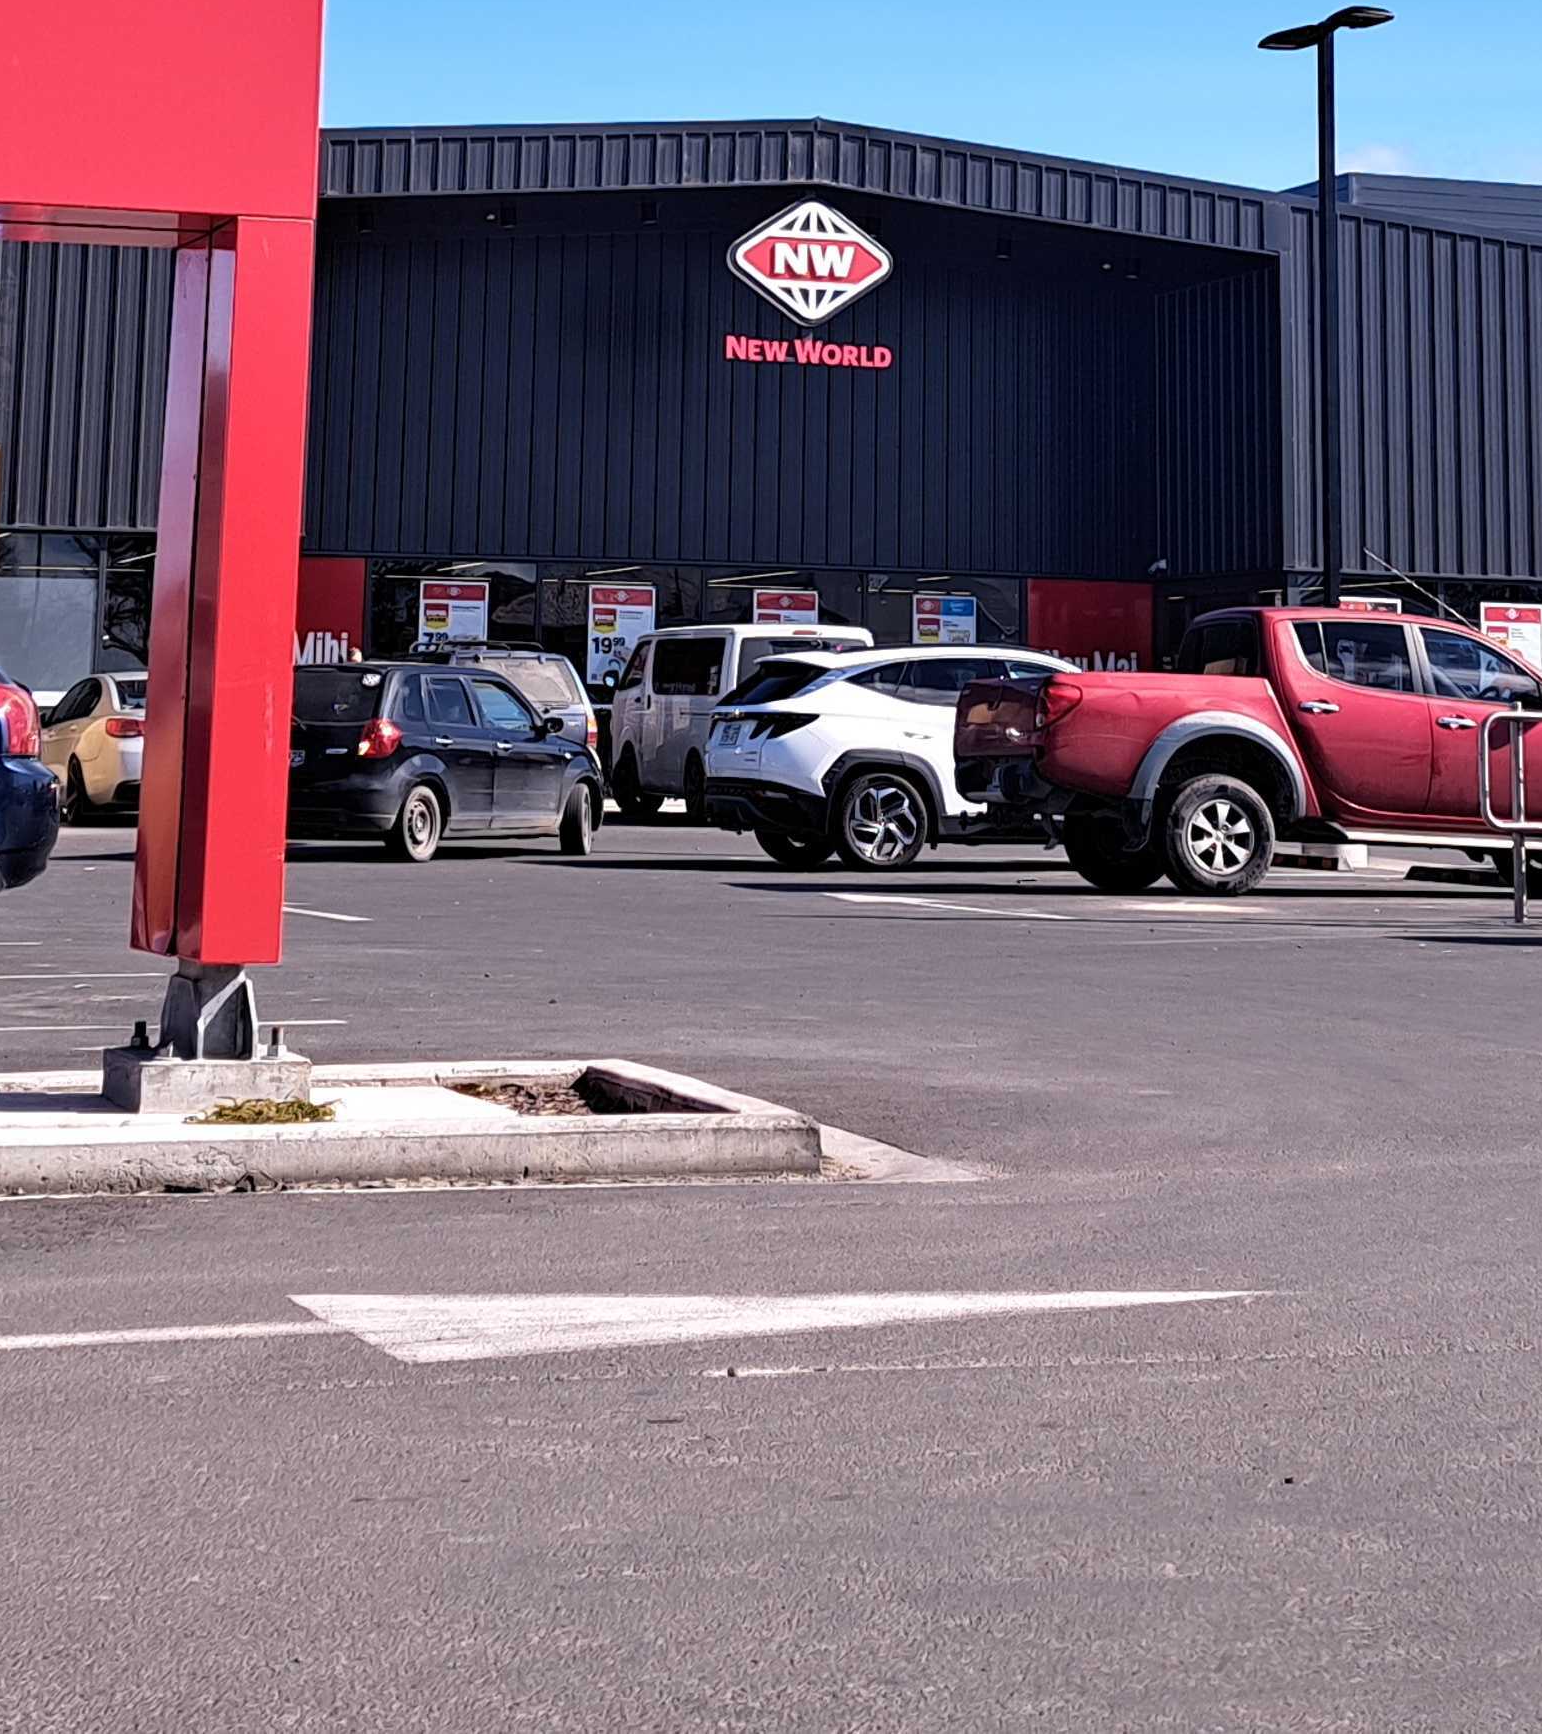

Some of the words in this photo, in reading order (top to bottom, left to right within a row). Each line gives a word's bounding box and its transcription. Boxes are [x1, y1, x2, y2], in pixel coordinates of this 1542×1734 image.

[773, 242, 855, 278] NW
[726, 335, 789, 362] NEW
[794, 339, 892, 368] WORLD
